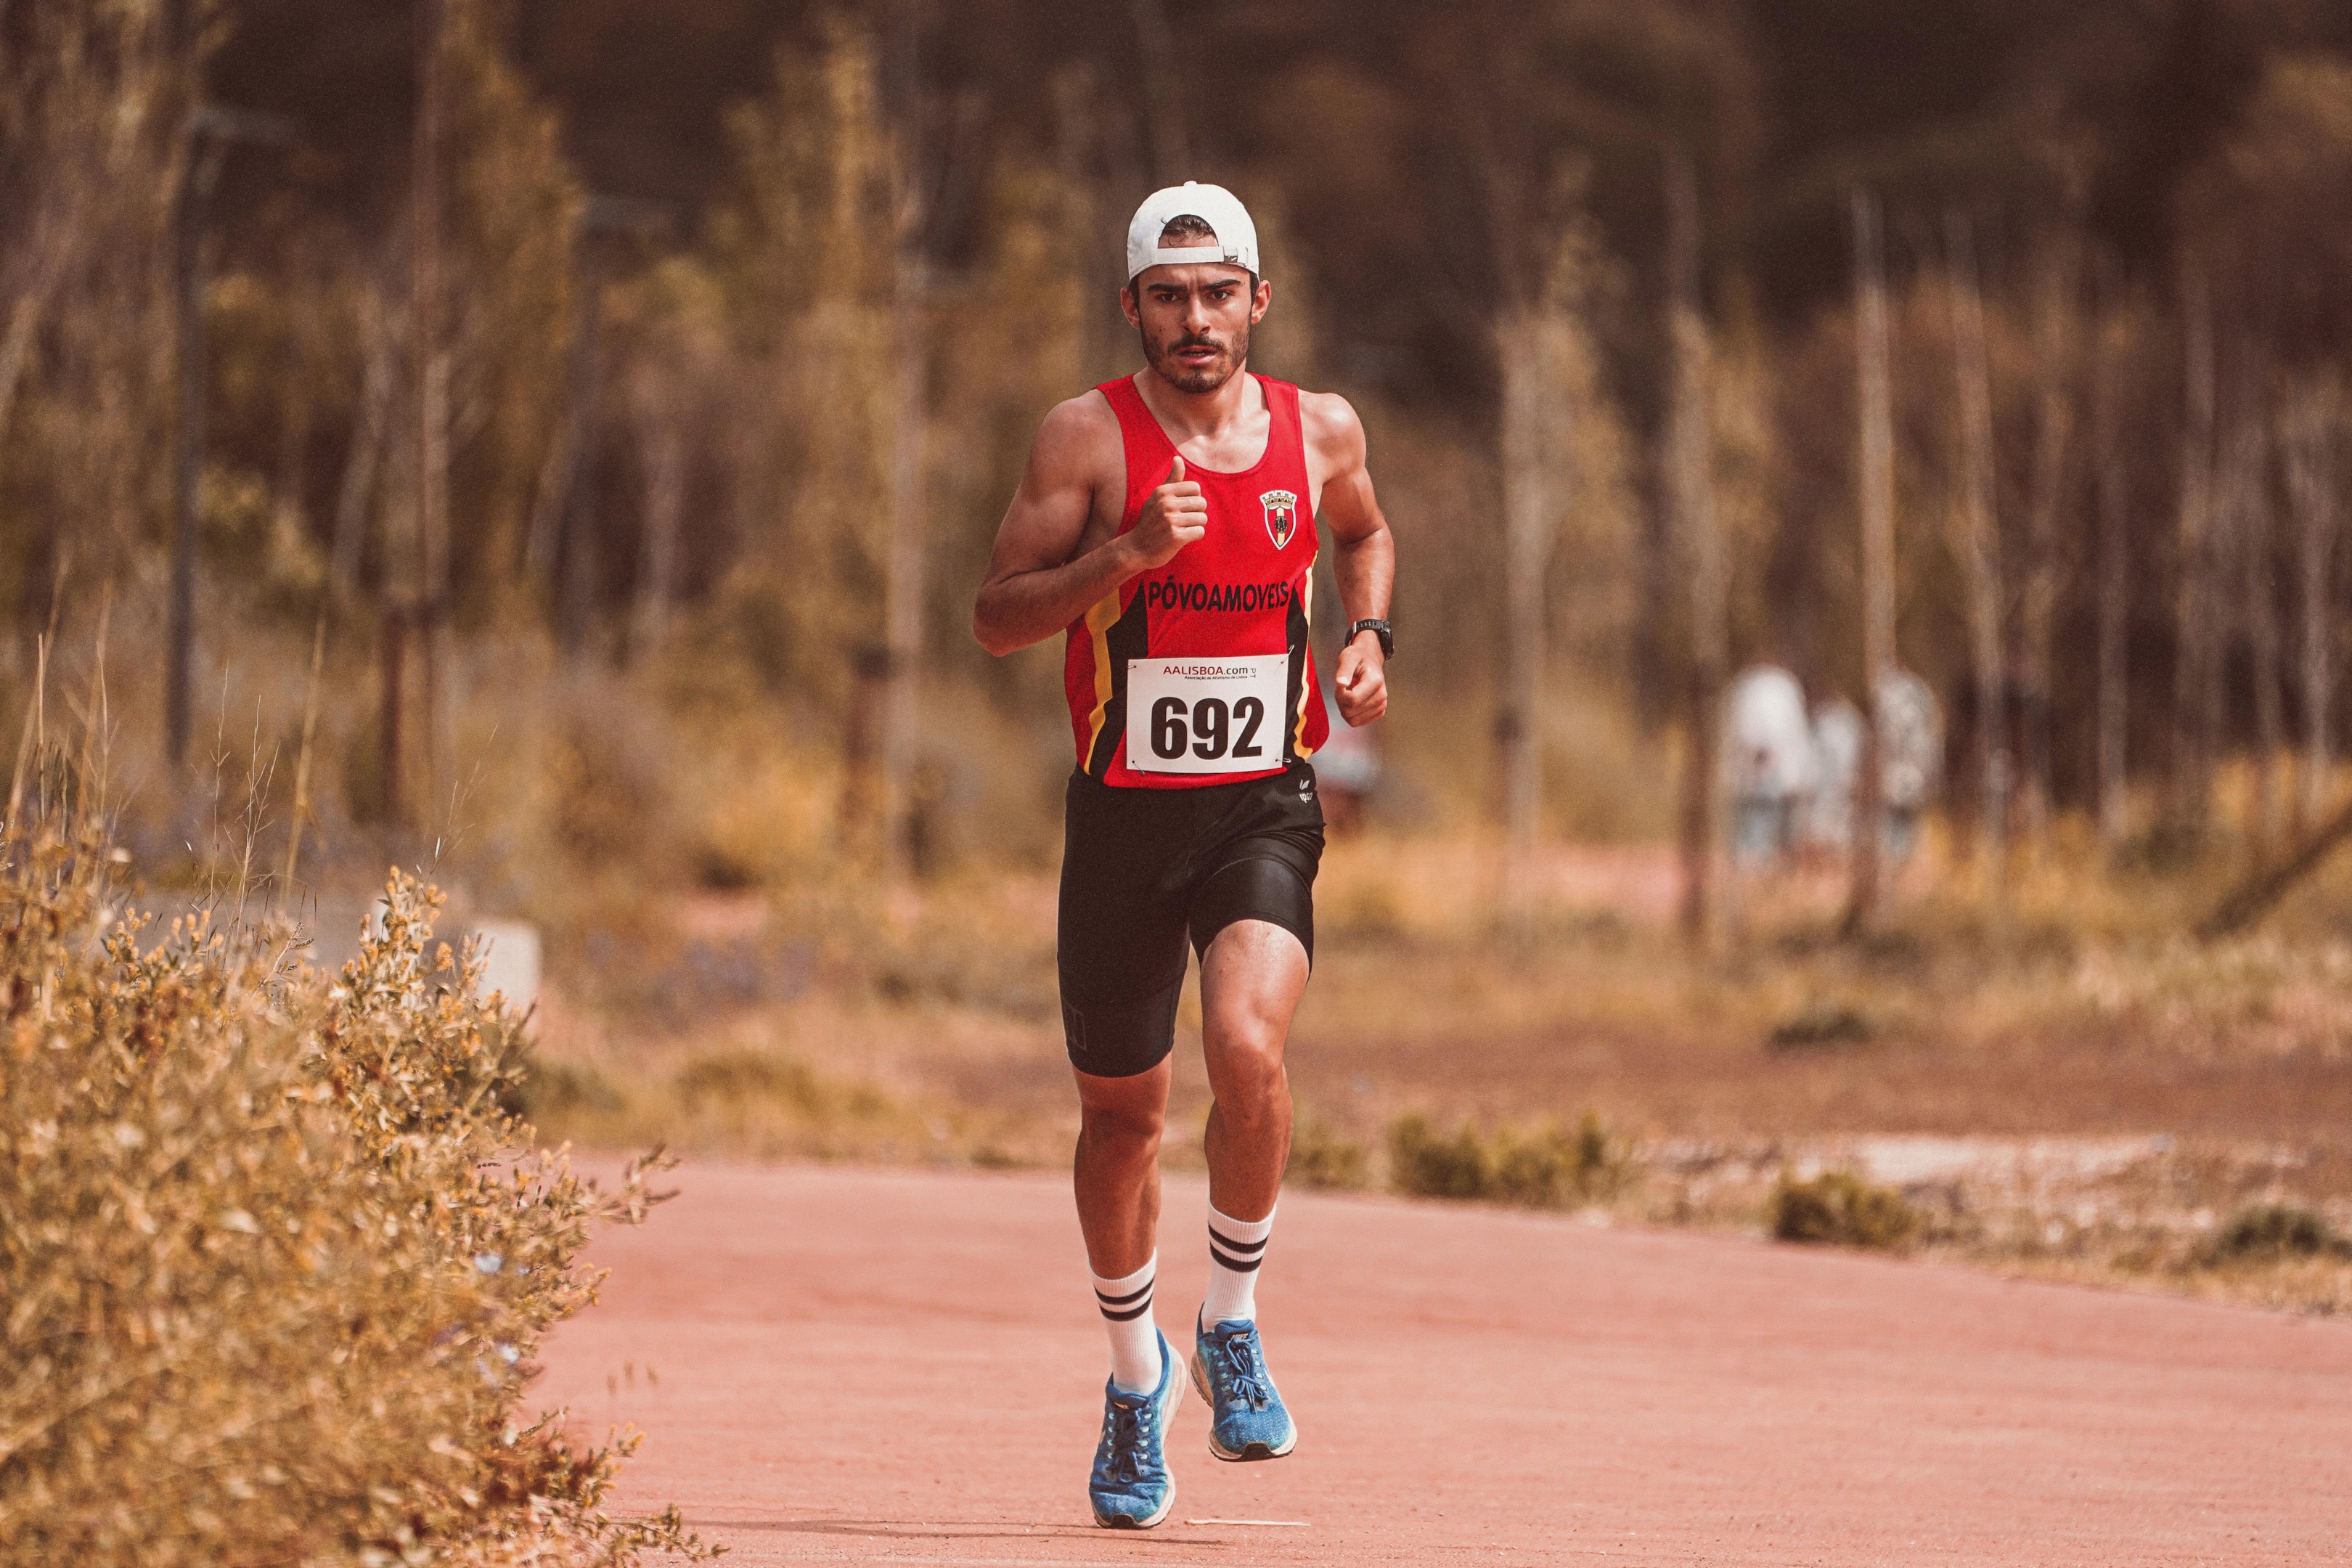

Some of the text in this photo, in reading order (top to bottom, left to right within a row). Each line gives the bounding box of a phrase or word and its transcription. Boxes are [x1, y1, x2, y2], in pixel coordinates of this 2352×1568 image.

[1148, 575, 1289, 612] PÓVOAMOVEIS
[1163, 666, 1248, 675] AALISBOA.com
[1151, 696, 1265, 760] 692
